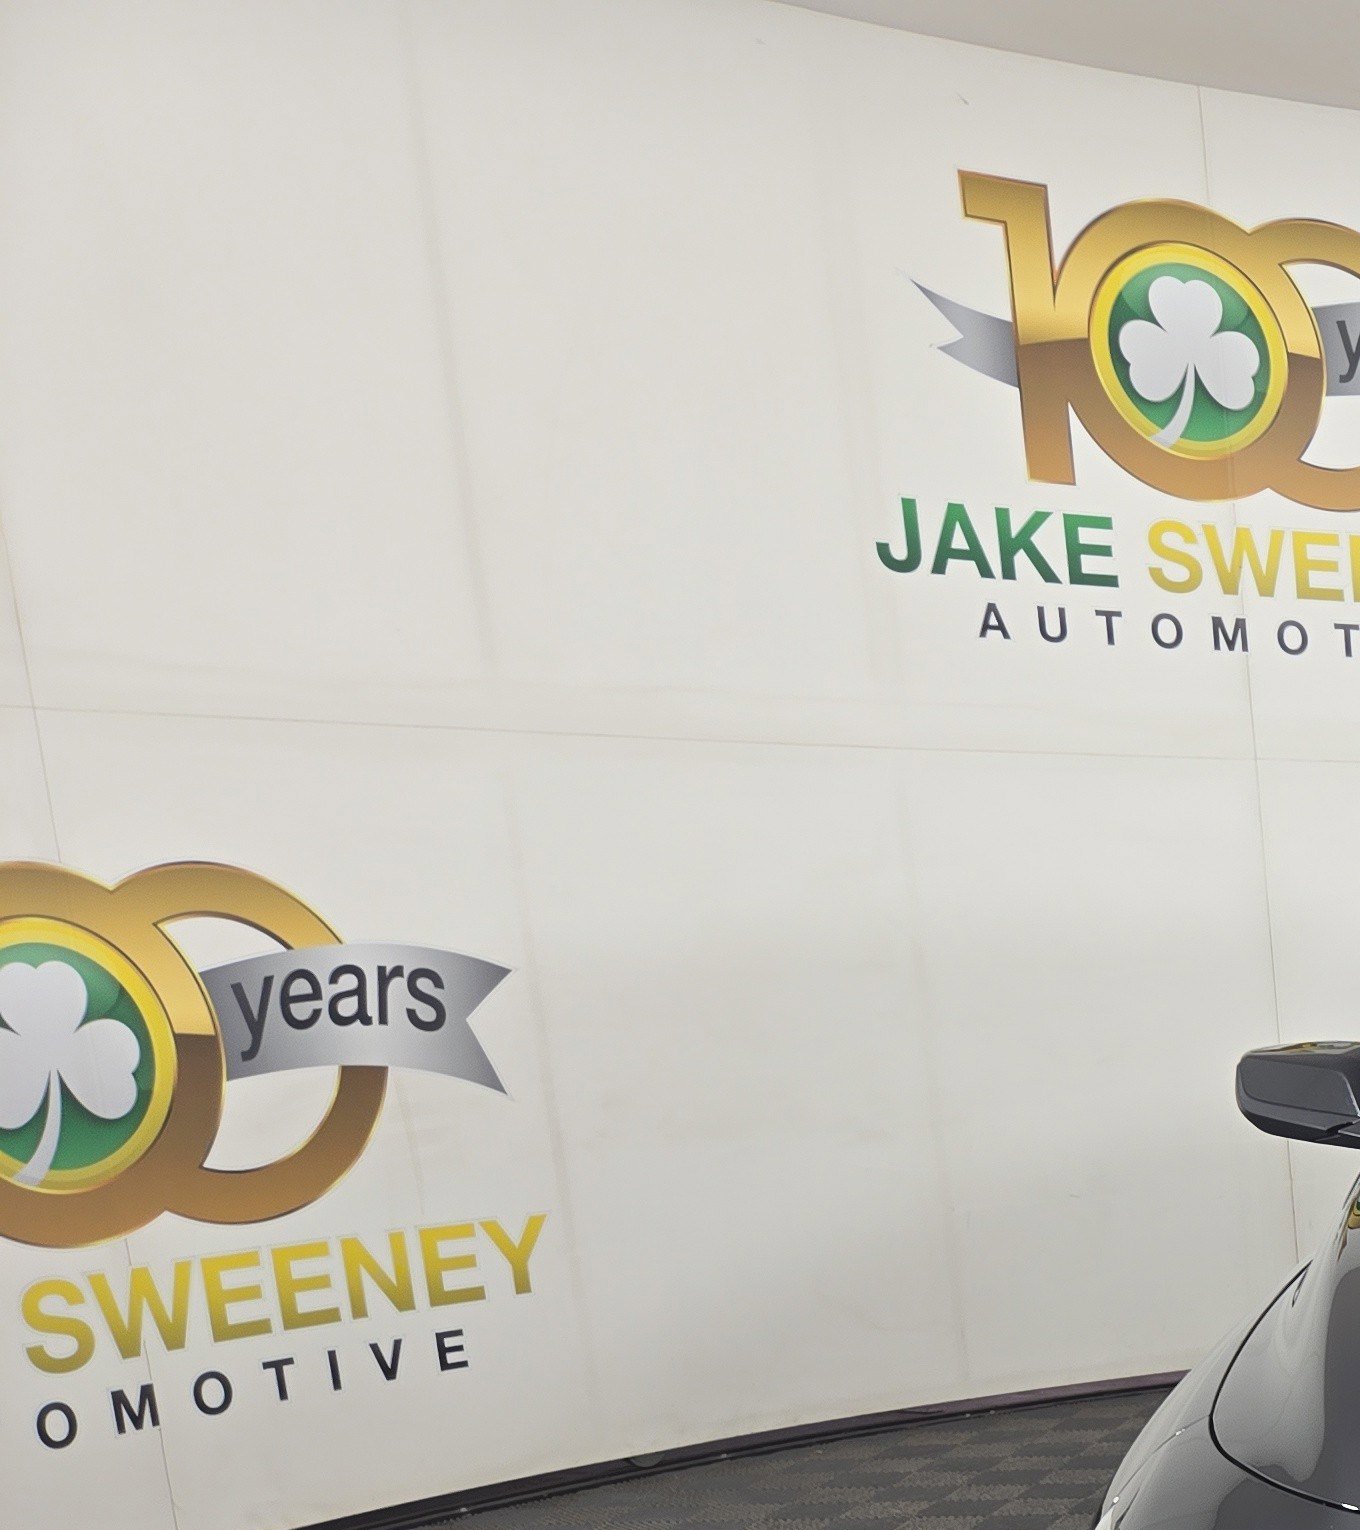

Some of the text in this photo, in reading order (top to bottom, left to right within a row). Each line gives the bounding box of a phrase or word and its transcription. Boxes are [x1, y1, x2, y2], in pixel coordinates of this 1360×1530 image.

[875, 496, 1119, 588] JAKE
[231, 963, 447, 1062] years
[21, 1213, 549, 1375] SWEENEY
[36, 1328, 470, 1450] OMOTIVE
